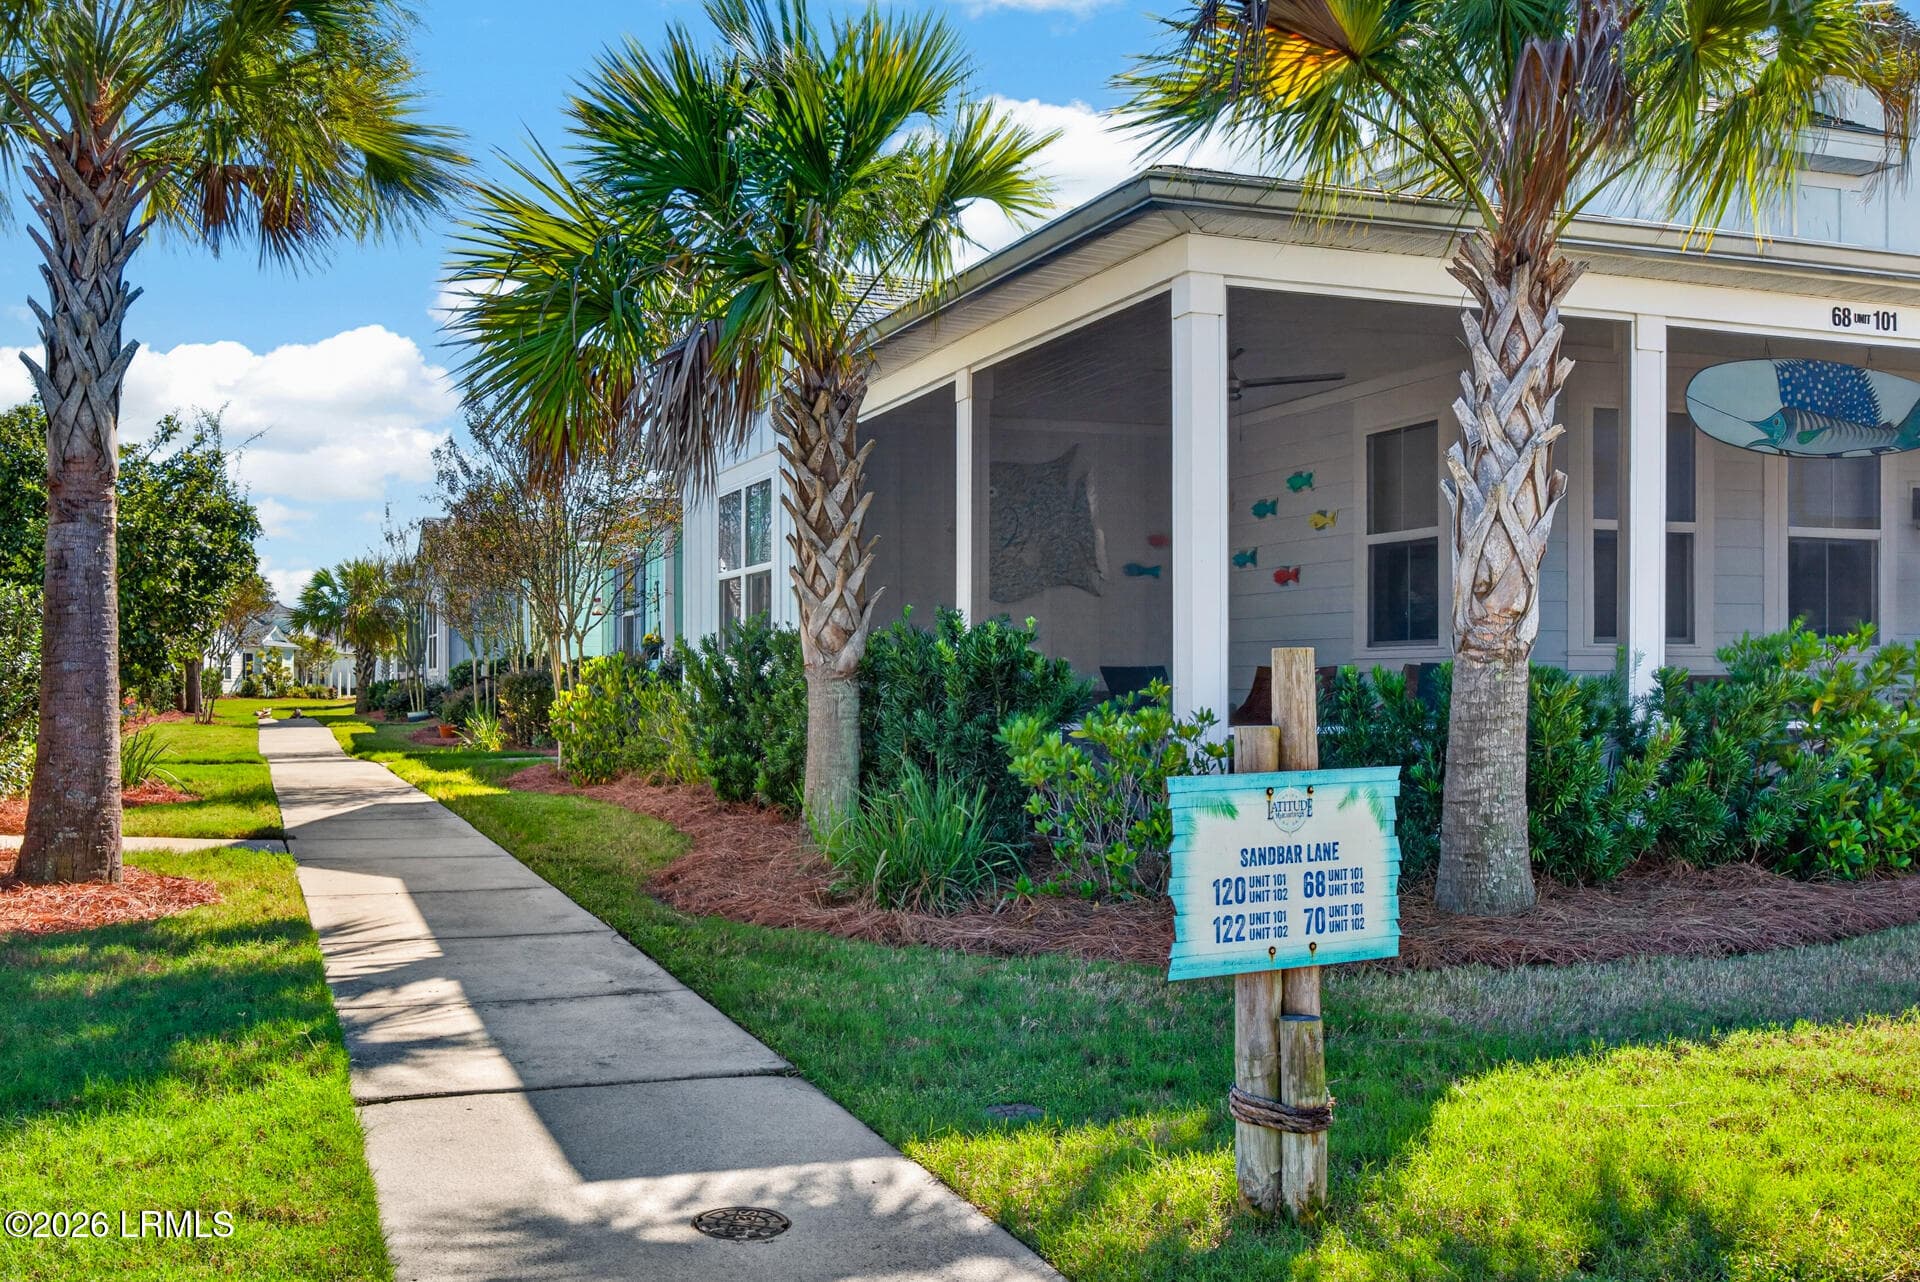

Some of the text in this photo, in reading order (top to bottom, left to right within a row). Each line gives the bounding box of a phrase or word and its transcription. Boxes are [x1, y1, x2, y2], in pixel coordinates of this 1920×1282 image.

[1831, 306, 1897, 332] 68 UNIT 101
[1266, 798, 1313, 820] LATITUDE
[1240, 841, 1340, 867] SANDBAR LANE
[1249, 873, 1287, 888] UNIT 101
[1328, 866, 1363, 882] UNIT 101
[1212, 876, 1246, 906] 120
[1303, 870, 1326, 899] 68
[1328, 881, 1365, 897] UNIT 102
[1249, 887, 1288, 903] UNIT 102
[1249, 910, 1287, 926] UNIT 101
[1328, 902, 1363, 918] UNIT 101
[1303, 906, 1326, 935] 70
[1328, 917, 1365, 933] UNIT 102
[1212, 914, 1246, 944] 122
[1249, 925, 1288, 941] UNIT 102
